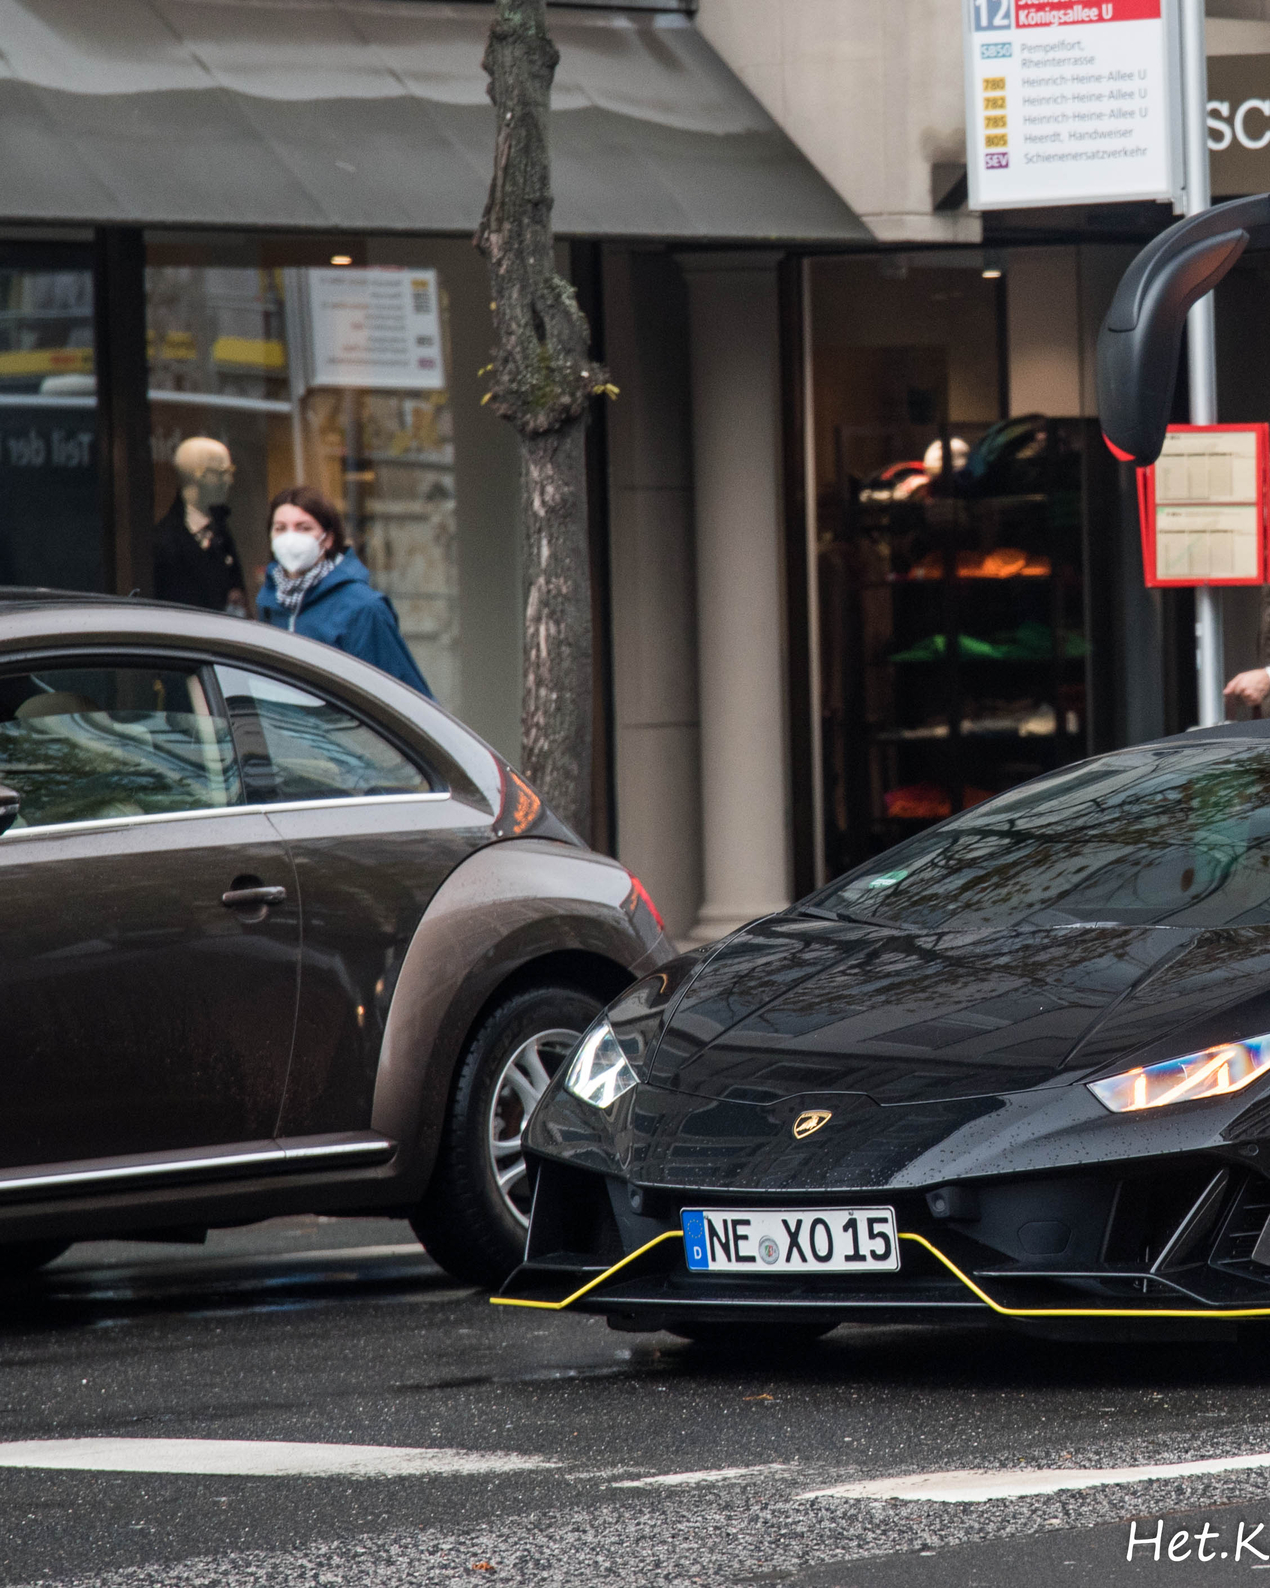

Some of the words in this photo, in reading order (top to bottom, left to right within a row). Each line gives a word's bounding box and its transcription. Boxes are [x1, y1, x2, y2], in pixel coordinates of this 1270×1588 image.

[1018, 6, 1099, 27] Königsallee
[1102, 4, 1113, 20] U
[1020, 39, 1085, 55] Pempelfort,
[1021, 55, 1095, 69] Rheinterrasse
[984, 97, 1006, 110] 782
[1068, 128, 1134, 143] Handweiser
[985, 153, 1009, 169] SEV
[1024, 146, 1148, 165] Schienenersatzverkehr
[707, 1217, 757, 1263] NE
[693, 1246, 702, 1260] D
